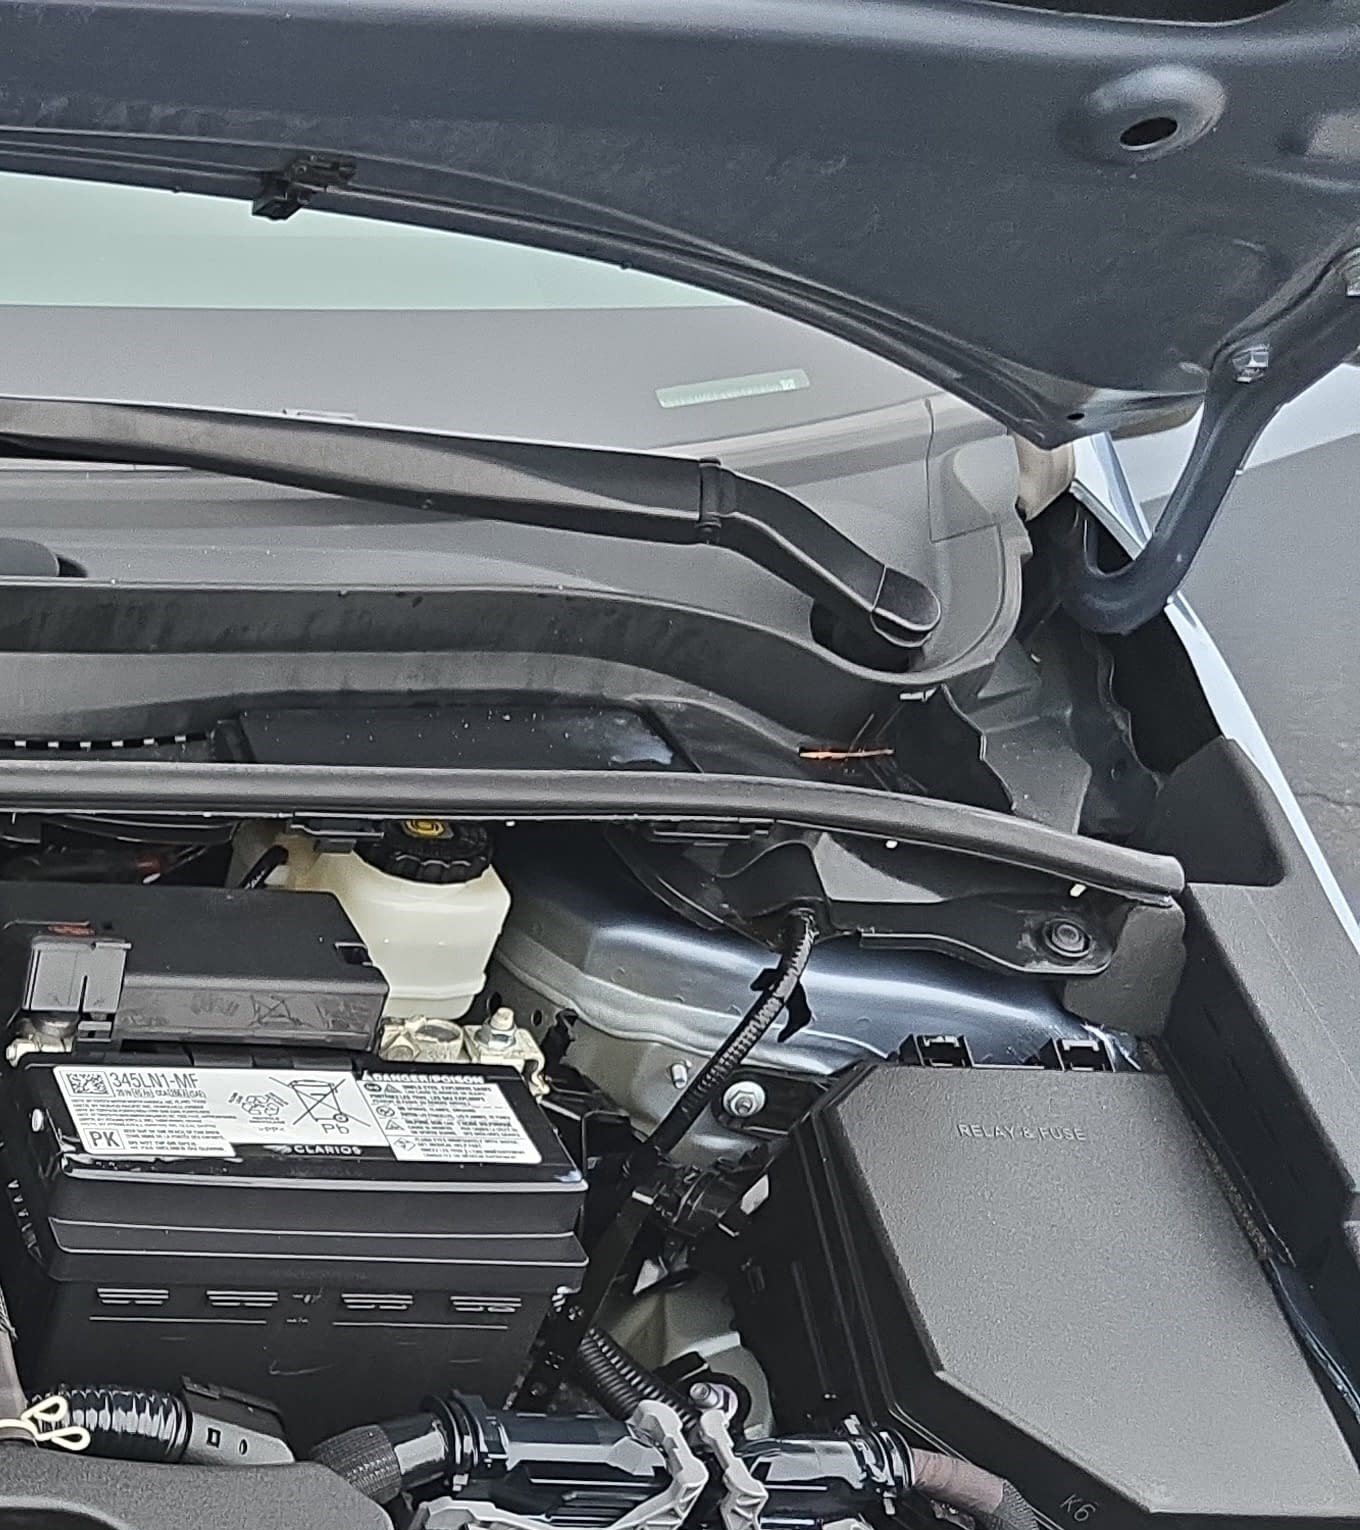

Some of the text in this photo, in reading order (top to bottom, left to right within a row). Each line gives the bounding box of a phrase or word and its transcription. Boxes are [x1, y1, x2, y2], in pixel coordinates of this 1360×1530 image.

[110, 1072, 199, 1089] 345LN1-MF
[321, 1123, 350, 1135] Pb
[957, 1124, 1086, 1141] RELAY & FUSE
[89, 1131, 120, 1148] PK
[294, 1145, 363, 1156] CLARIOS
